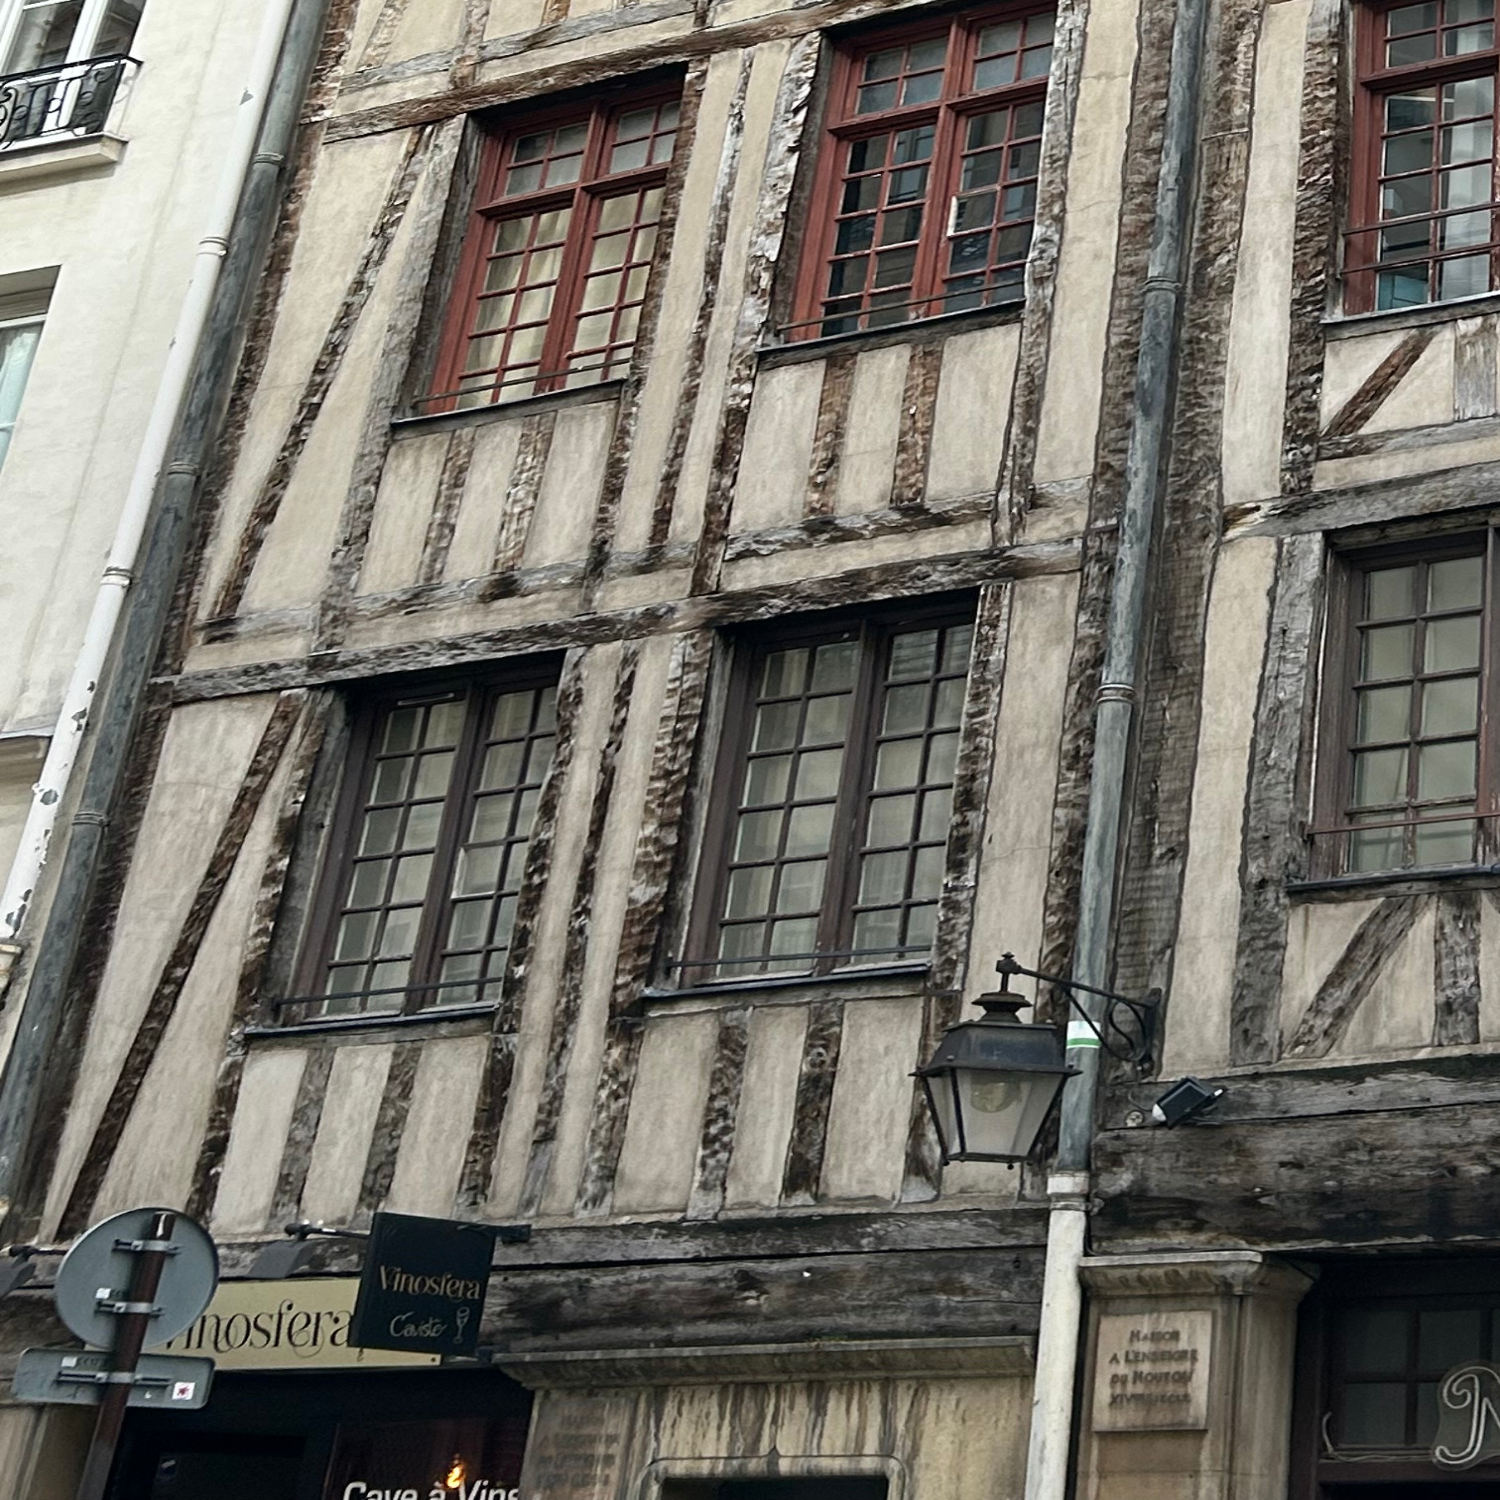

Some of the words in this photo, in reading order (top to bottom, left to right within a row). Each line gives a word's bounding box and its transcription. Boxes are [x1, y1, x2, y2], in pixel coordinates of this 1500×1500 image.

[379, 1265, 481, 1303] Vinosfera
[166, 1299, 352, 1358] inosfera
[343, 1481, 418, 1500] Cave
